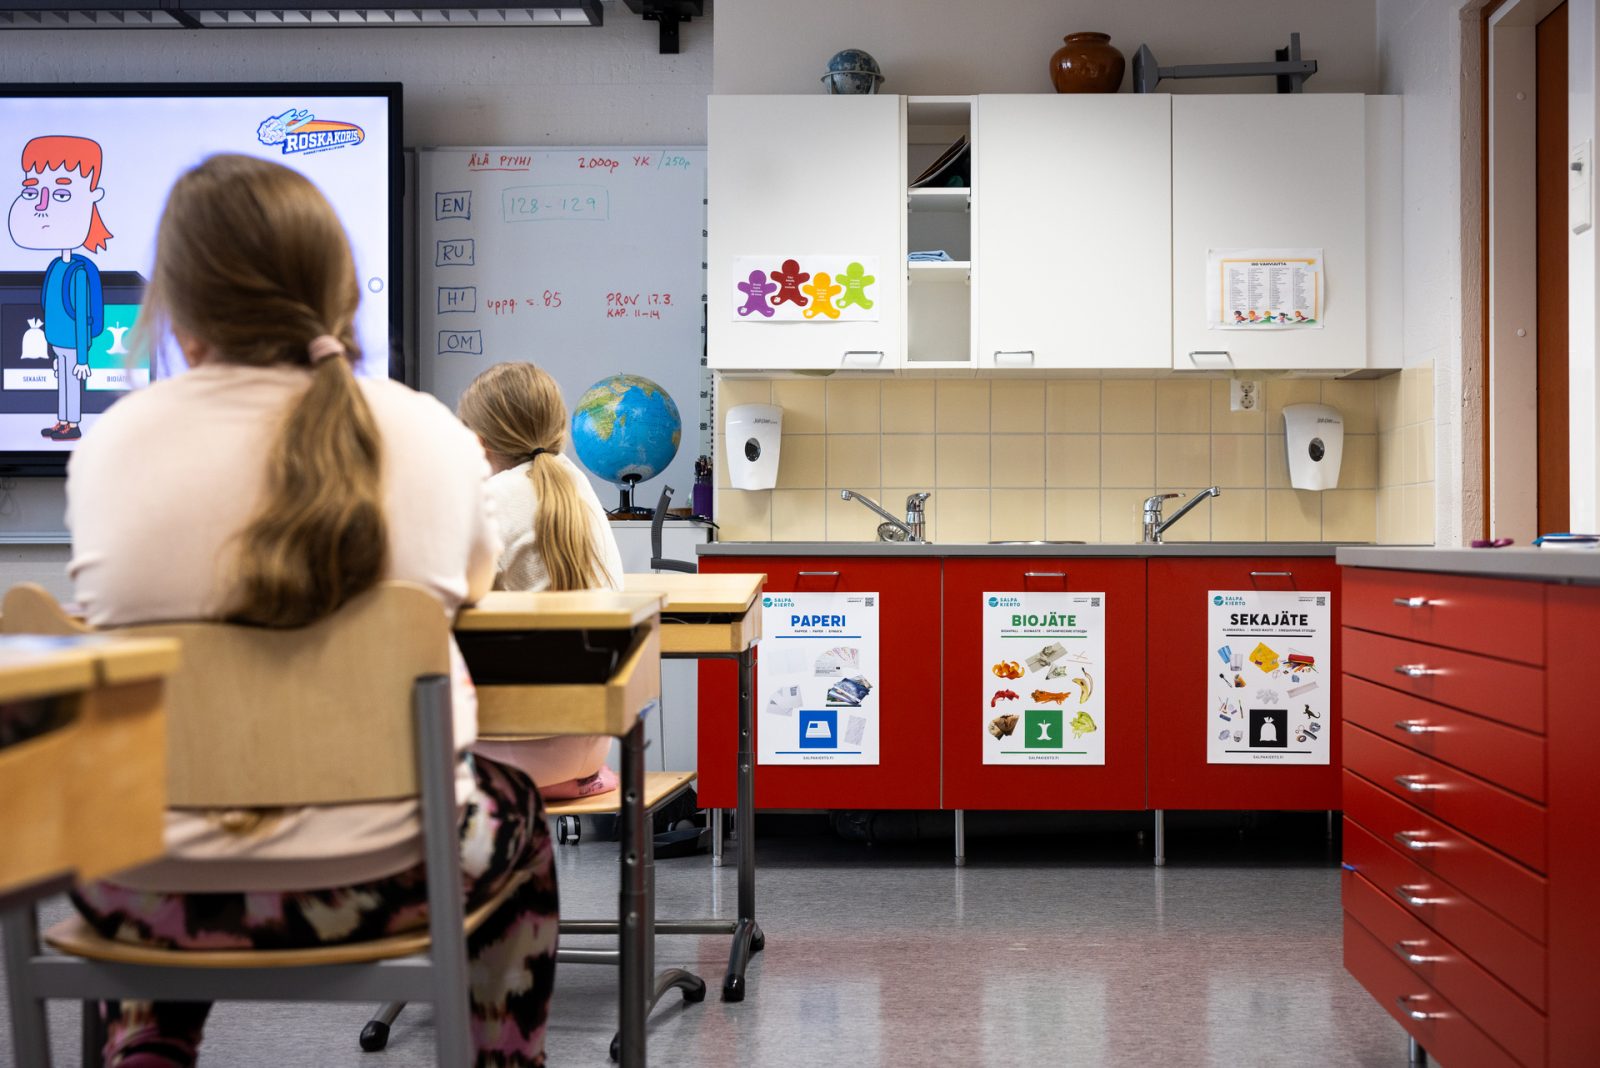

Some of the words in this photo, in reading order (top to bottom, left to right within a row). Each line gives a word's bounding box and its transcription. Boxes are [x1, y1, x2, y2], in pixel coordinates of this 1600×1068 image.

[285, 130, 359, 153] ROSKAKORIS
[468, 153, 490, 167] ÄLÄ
[500, 155, 532, 167] PYYHI
[578, 156, 620, 175] 2.000p
[633, 155, 650, 167] YK
[442, 197, 465, 213] EN
[510, 197, 540, 214] 128
[543, 289, 562, 308] 85
[607, 293, 638, 307] PROV
[447, 334, 473, 350] OM
[791, 614, 846, 627] PAPERI
[1012, 611, 1077, 627] BIOJÄTE
[1230, 610, 1308, 626] SEKAJÄTE
